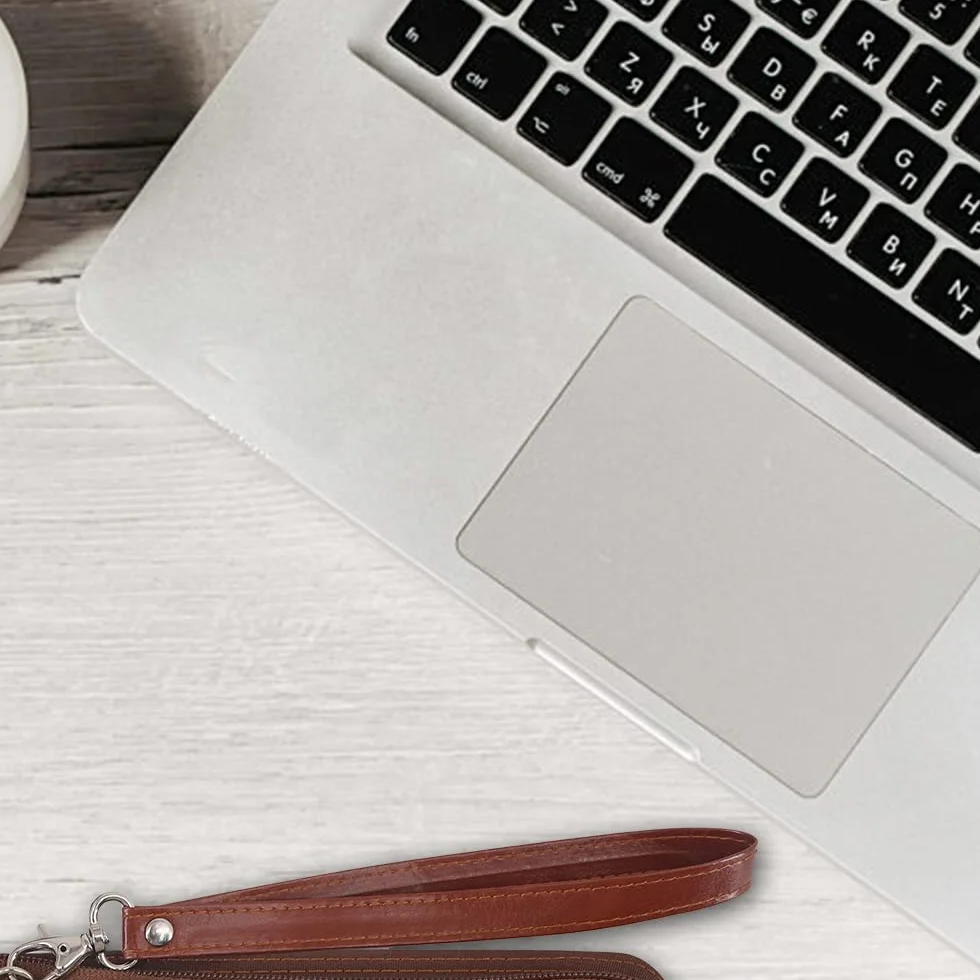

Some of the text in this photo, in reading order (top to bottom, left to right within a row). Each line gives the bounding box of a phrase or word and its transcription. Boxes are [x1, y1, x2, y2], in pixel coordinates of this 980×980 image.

[929, 3, 946, 20] 5
[698, 13, 716, 32] S
[405, 27, 419, 43] fn
[857, 30, 876, 51] R
[619, 51, 640, 73] Z
[762, 57, 783, 77] D
[466, 72, 489, 90] ctrl
[626, 77, 644, 94] Я
[926, 75, 942, 94] T
[684, 96, 707, 119] X
[829, 104, 848, 120] F
[752, 143, 771, 163] C
[894, 148, 915, 168] G
[595, 162, 625, 185] cmd
[819, 187, 837, 207] V
[882, 234, 900, 254] B
[947, 279, 970, 302] N
